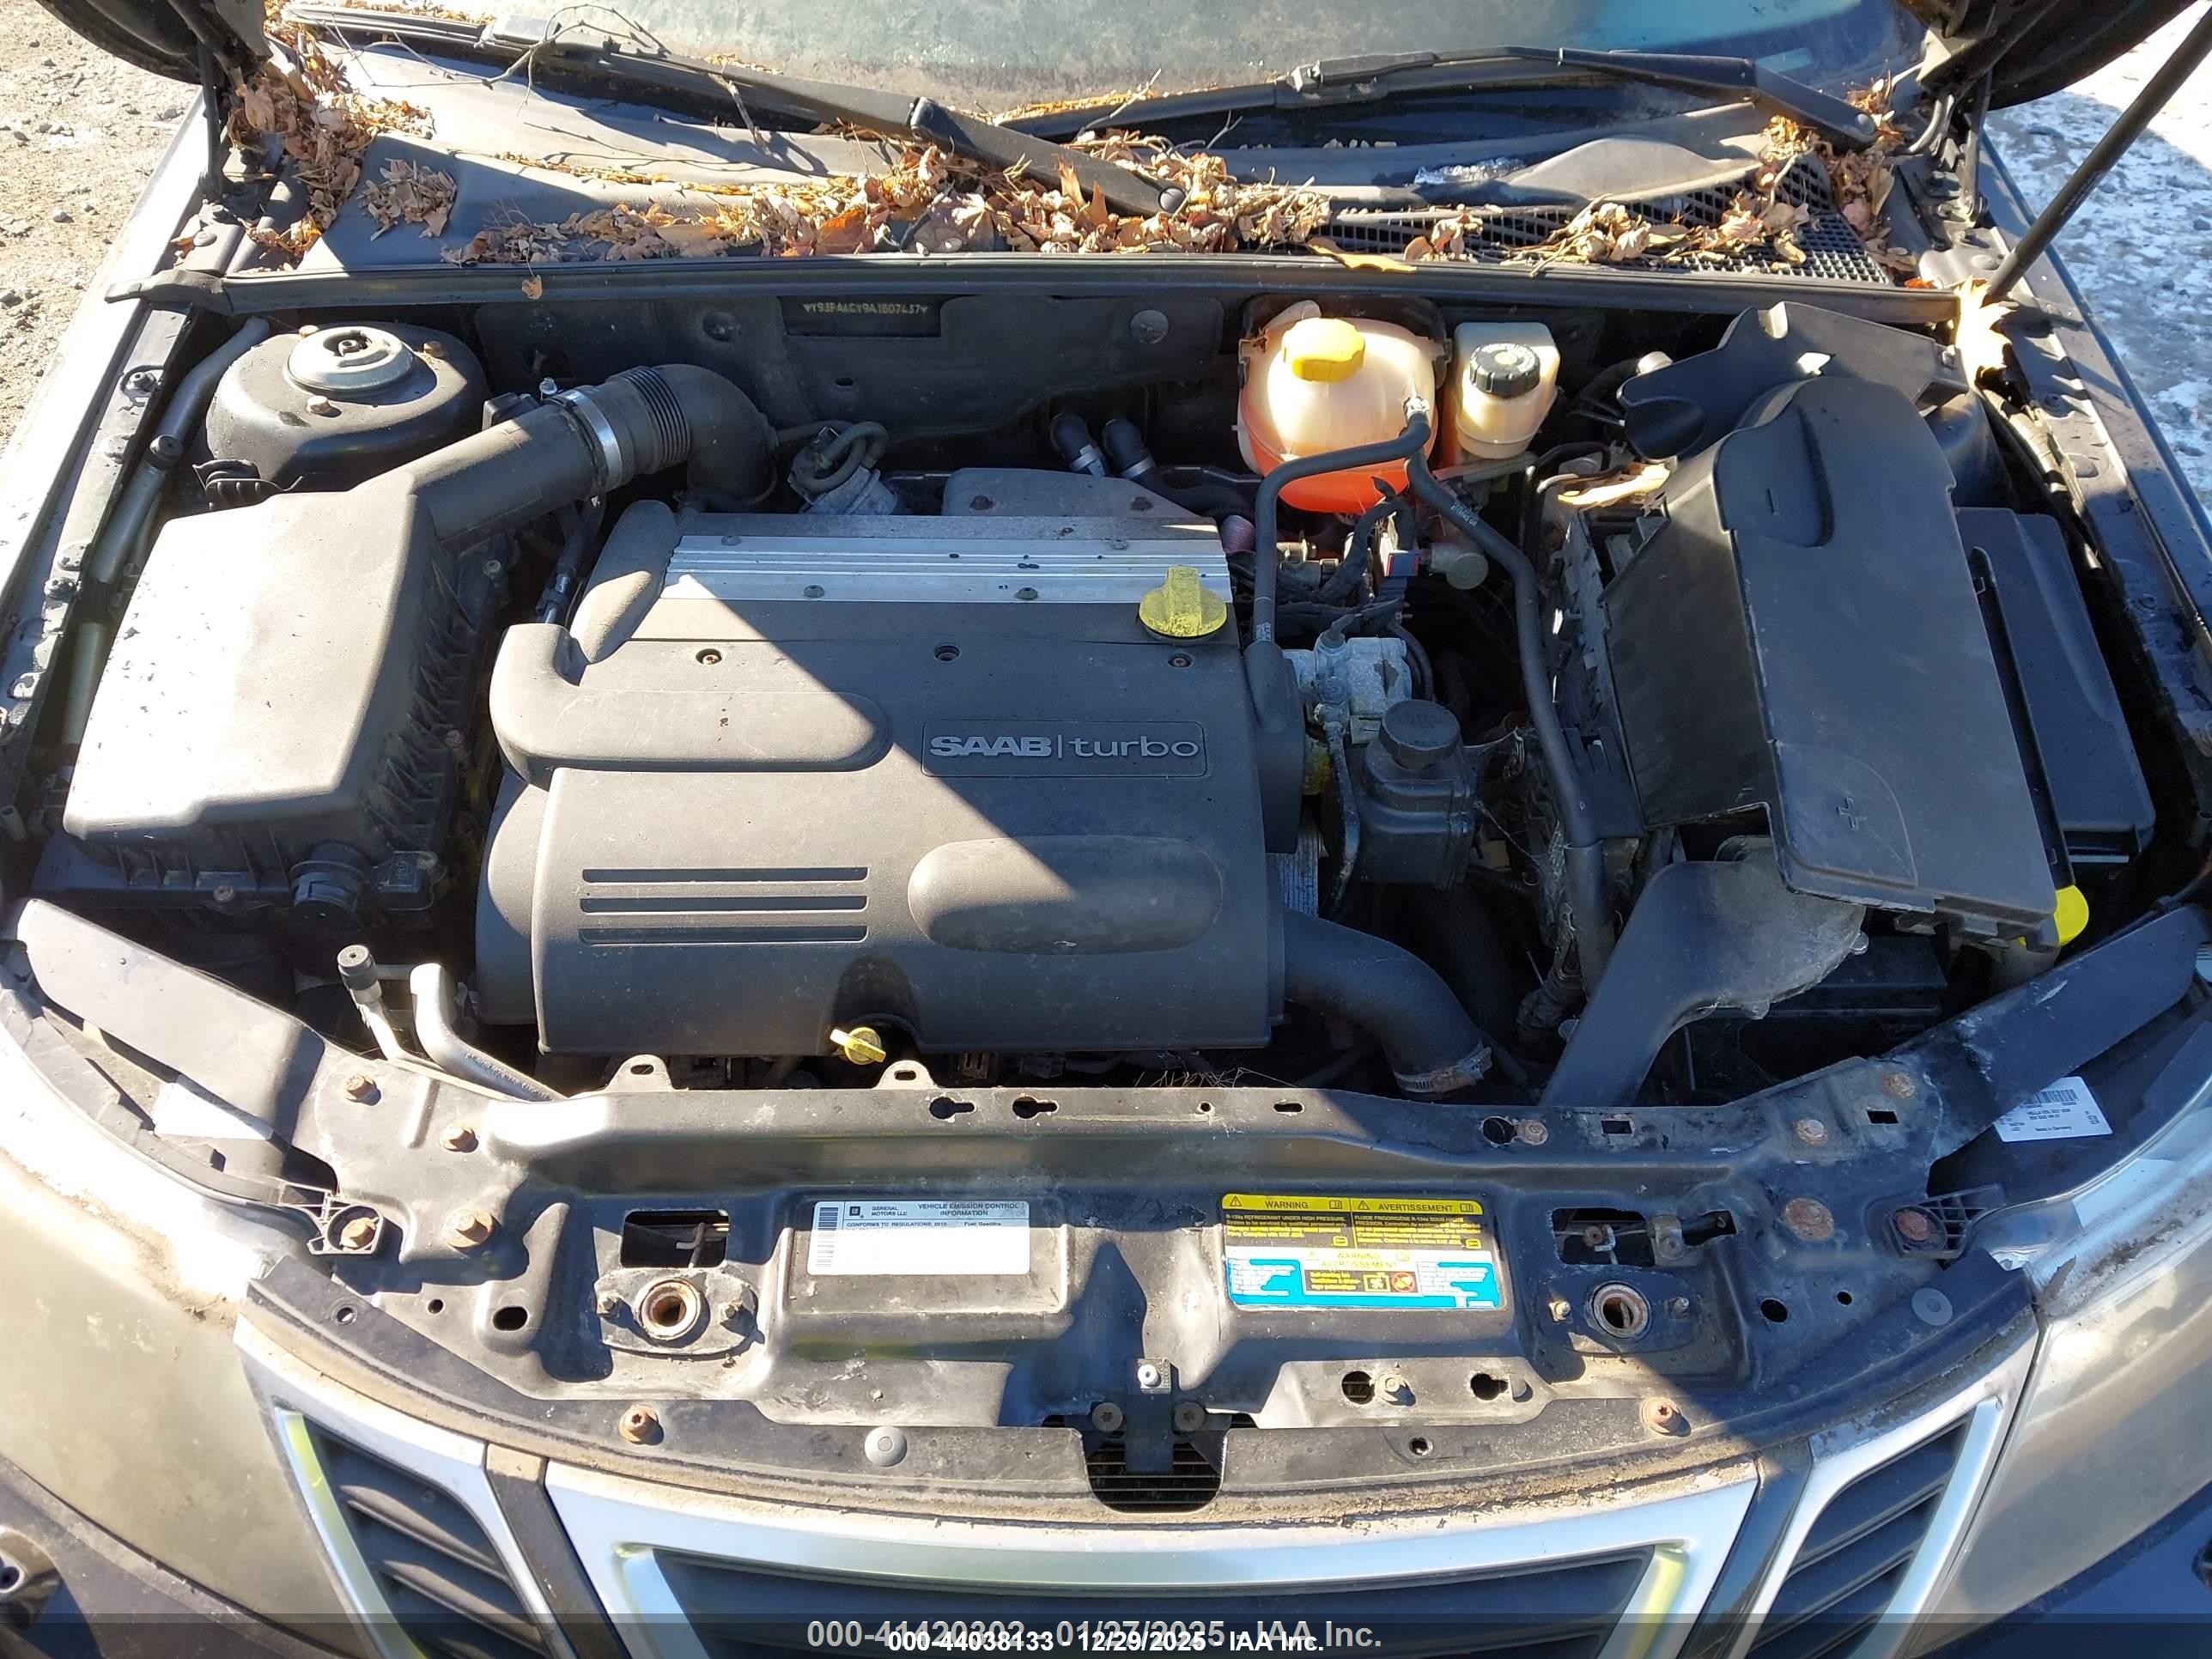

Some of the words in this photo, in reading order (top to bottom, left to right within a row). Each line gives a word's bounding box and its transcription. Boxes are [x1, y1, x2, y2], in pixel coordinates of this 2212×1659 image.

[930, 737, 1052, 757] SAAB
[1068, 736, 1199, 757] turbo
[1265, 1200, 1309, 1209] WARNING
[1378, 1203, 1453, 1212] AVERTISSEMENT
